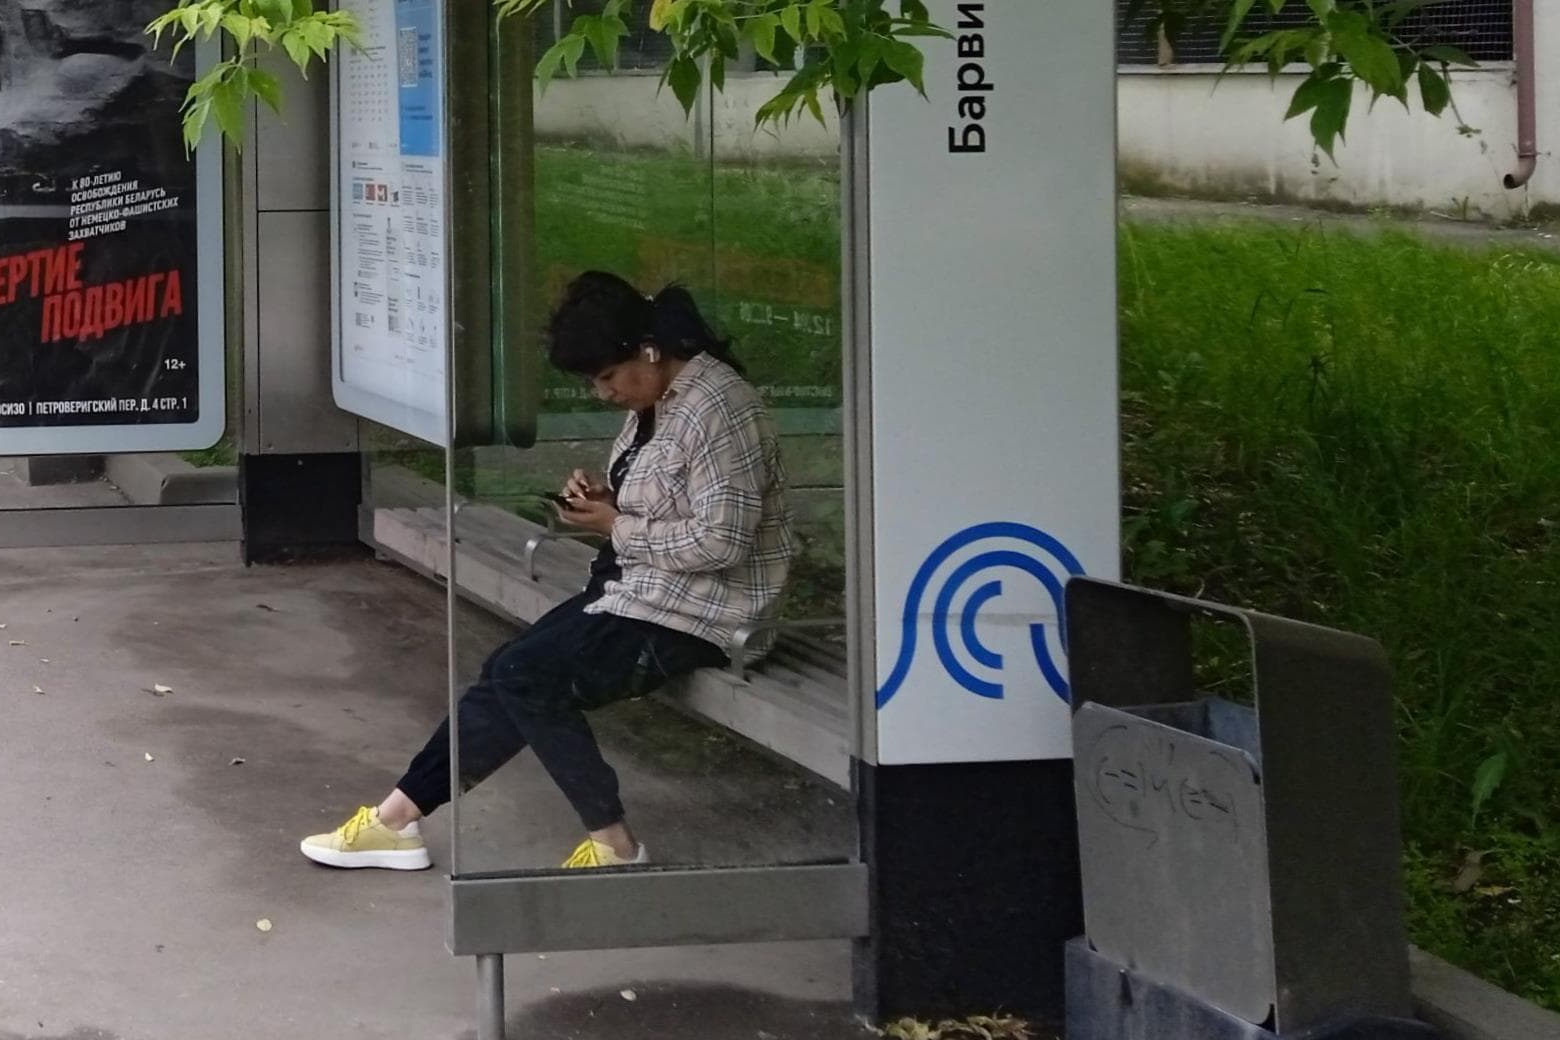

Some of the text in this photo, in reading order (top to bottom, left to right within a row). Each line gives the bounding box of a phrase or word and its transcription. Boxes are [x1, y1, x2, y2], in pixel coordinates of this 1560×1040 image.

[70, 187, 166, 216] РЕСПУБЛИКИ БЕЛАРУСЬ
[71, 180, 138, 203] ОСВОБОЖДЕНИЯ
[69, 197, 179, 228] ОТ НЕМЕЦКО-ФАШИСТСКИХ
[68, 220, 126, 241] ЗАХВАТЧИКОВ
[41, 270, 182, 344] ПОДВИГА
[164, 359, 186, 370] 12+
[36, 397, 117, 415] ПЕТРОВЕРИГСКИЙ
[119, 399, 139, 412] ПЕР.
[141, 398, 151, 412] Д.
[152, 397, 159, 410] 4
[160, 397, 180, 410] СТР.
